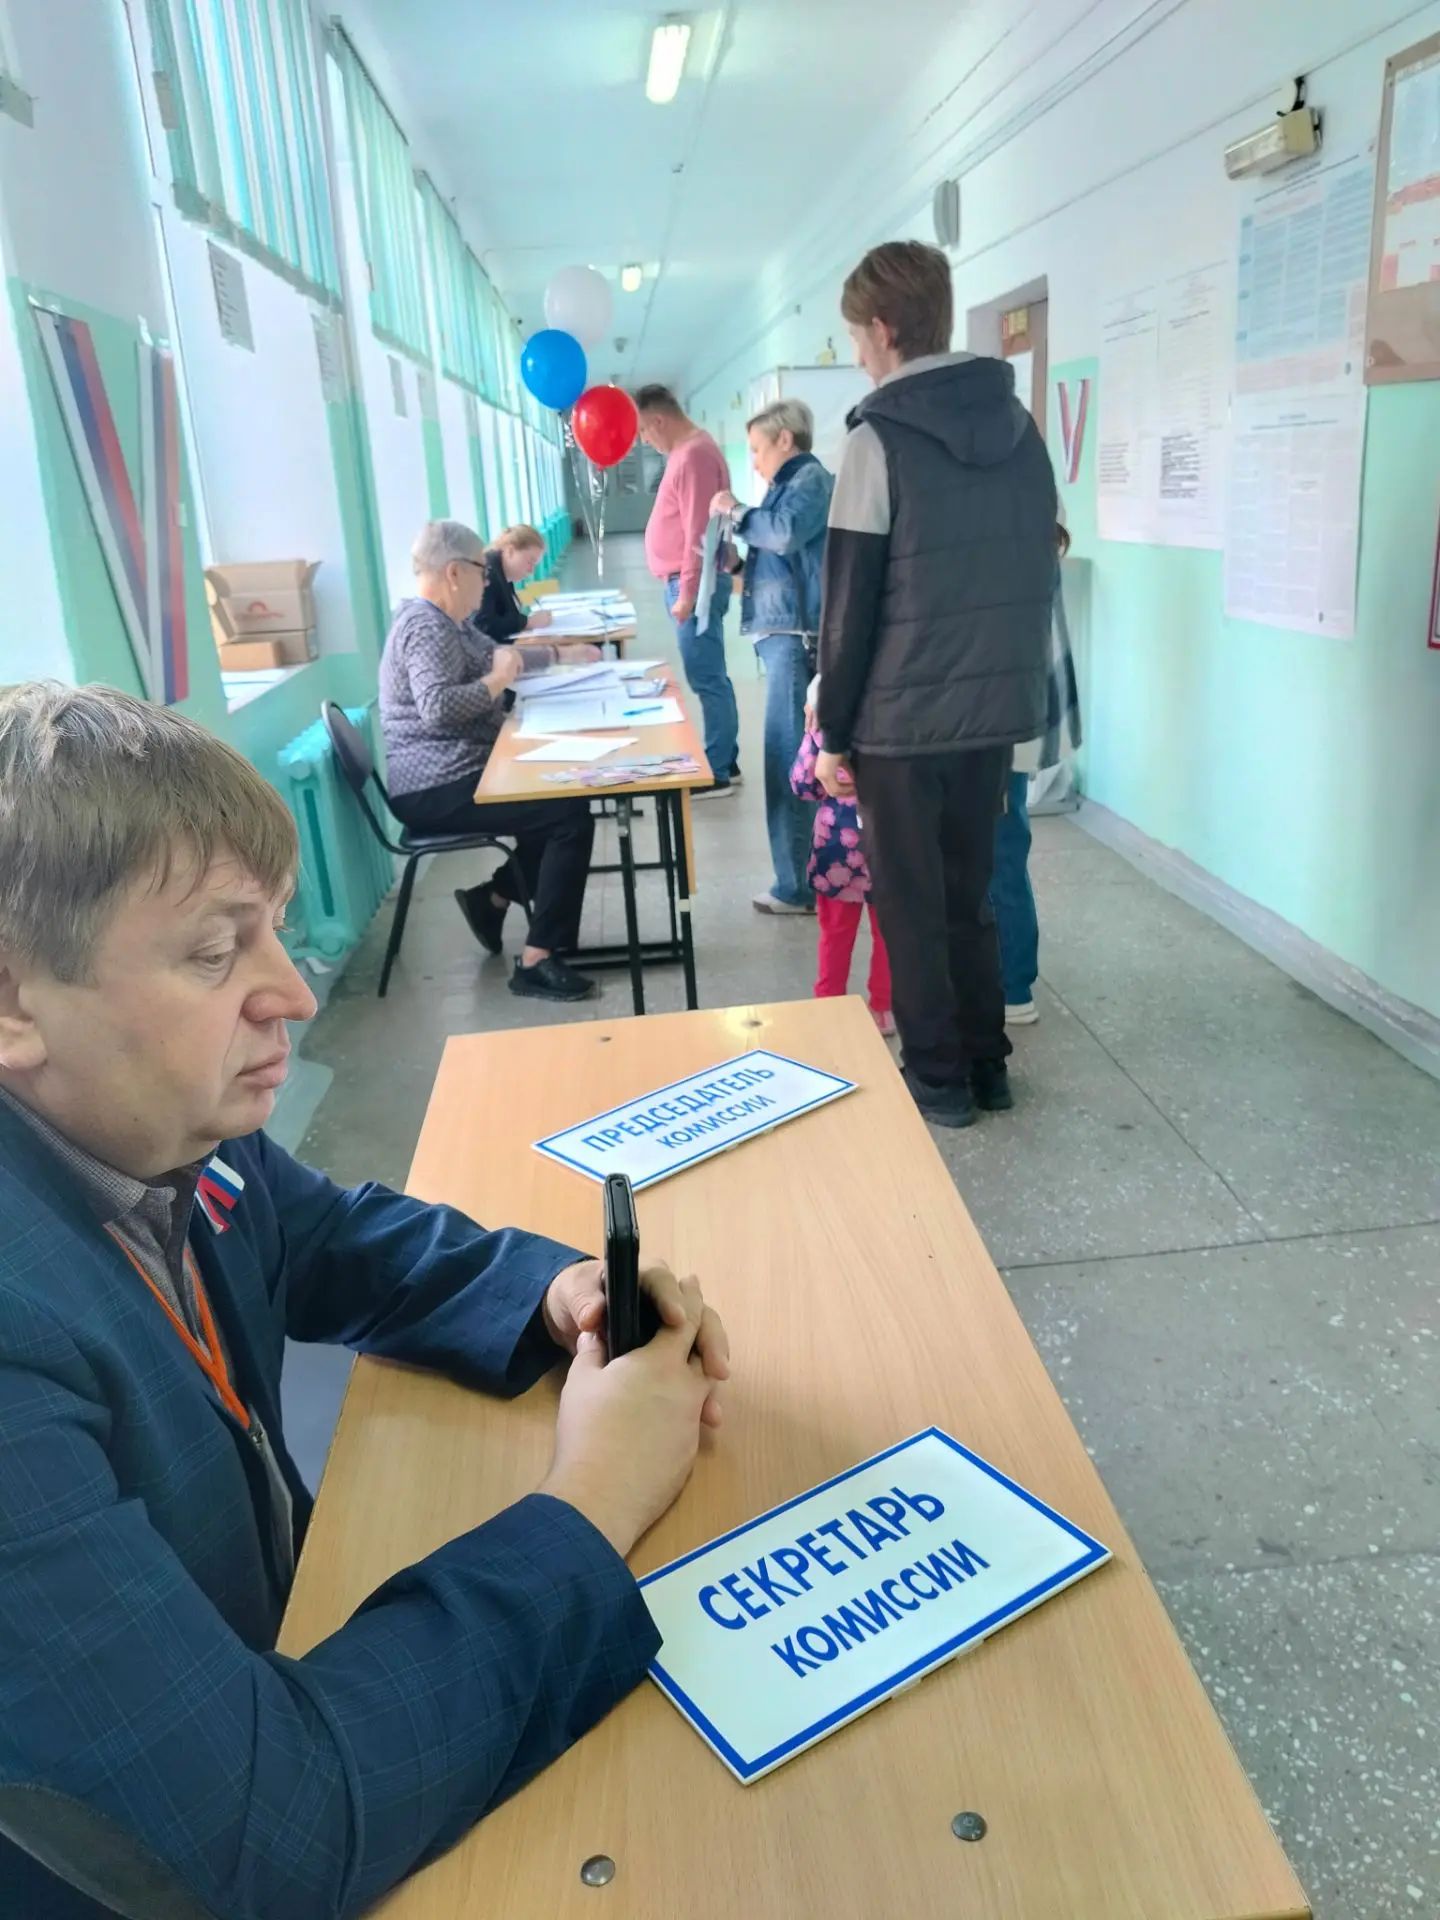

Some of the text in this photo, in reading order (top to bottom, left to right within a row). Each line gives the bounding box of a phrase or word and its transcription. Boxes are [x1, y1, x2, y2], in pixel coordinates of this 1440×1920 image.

[581, 1068, 776, 1152] ПРЕДСЕДАТЕЛЬ
[656, 1095, 776, 1149] КОМИССИИ
[698, 1487, 945, 1631] СЕКРЕТАРЬ
[771, 1539, 991, 1679] КОМИССИИ
